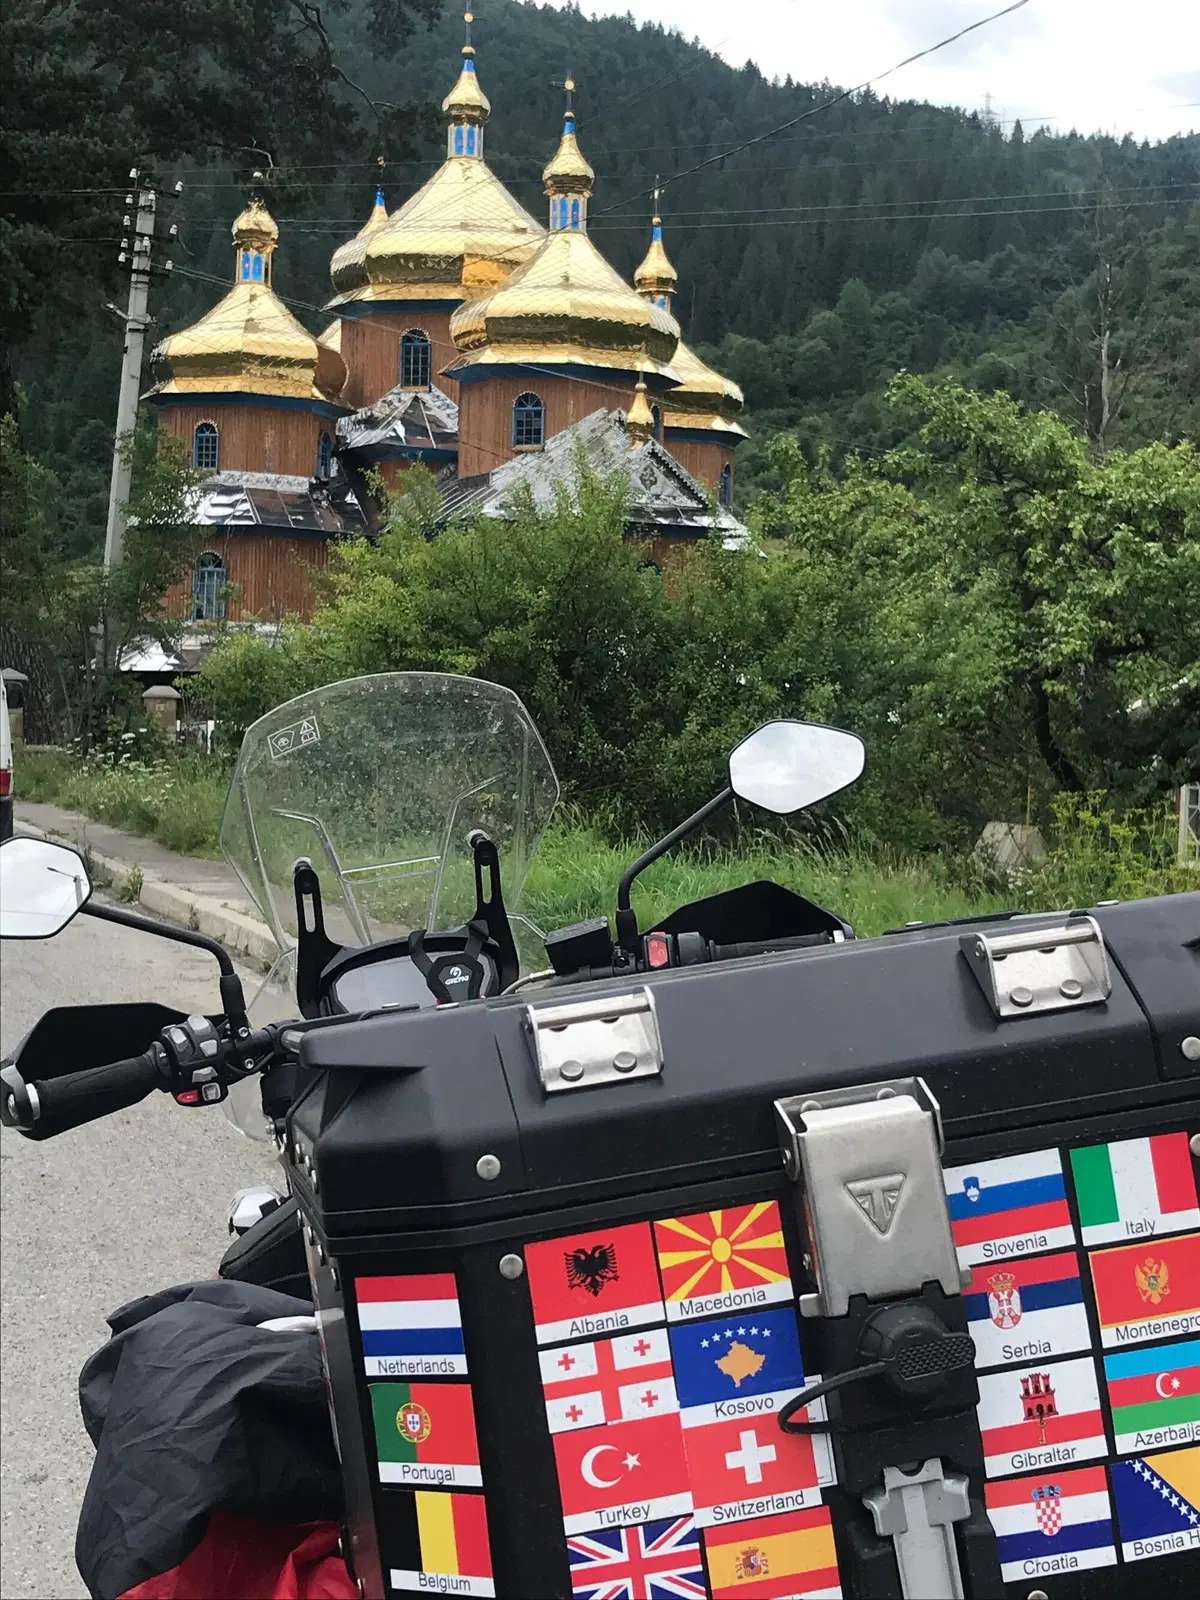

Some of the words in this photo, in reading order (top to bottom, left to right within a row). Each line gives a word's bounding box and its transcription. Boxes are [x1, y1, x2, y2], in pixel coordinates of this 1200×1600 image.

[1125, 1218, 1157, 1236] Italy
[982, 1234, 1048, 1258] Slovenia
[680, 1288, 767, 1317] Macedonia
[570, 1313, 630, 1336] Albania
[1002, 1340, 1052, 1360] Serbia
[378, 1359, 456, 1375] Netherlands
[714, 1396, 775, 1418] Kosovo
[1011, 1446, 1077, 1470] Gibraltar
[402, 1464, 456, 1486] Portugal
[595, 1504, 651, 1525] Turkey
[712, 1490, 805, 1521] Switzerland
[1133, 1535, 1185, 1557] Bosnia
[1023, 1554, 1079, 1576] Croatia
[418, 1572, 471, 1592] Belgium
